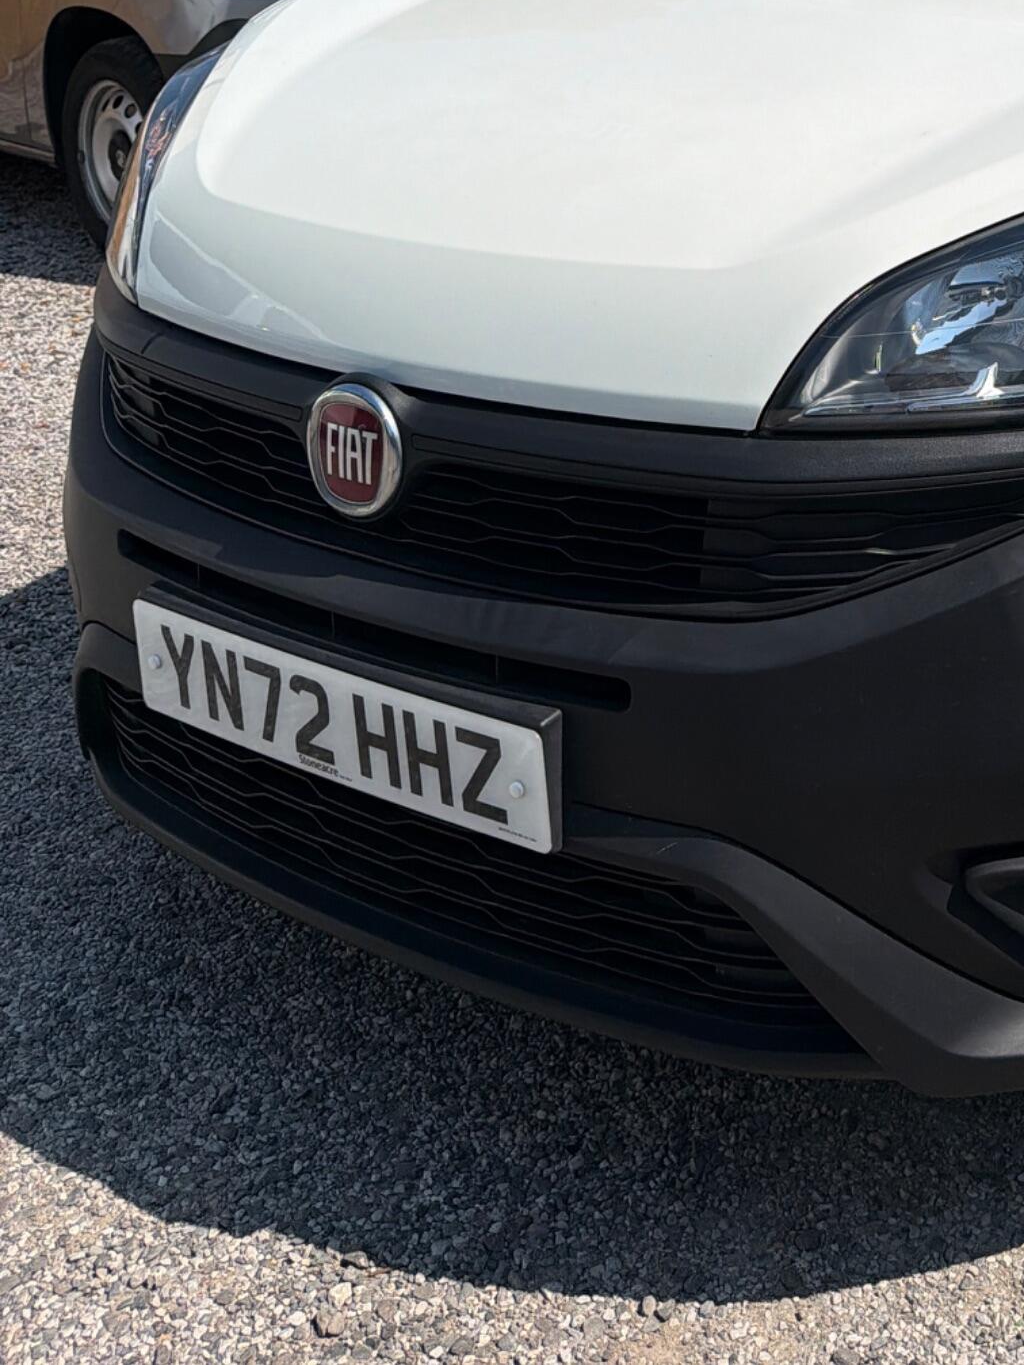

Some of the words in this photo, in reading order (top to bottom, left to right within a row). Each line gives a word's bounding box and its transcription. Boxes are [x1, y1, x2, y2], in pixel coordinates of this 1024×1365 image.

[326, 422, 377, 485] FIAT
[160, 624, 336, 765] YN72
[352, 693, 509, 826] HHZ
